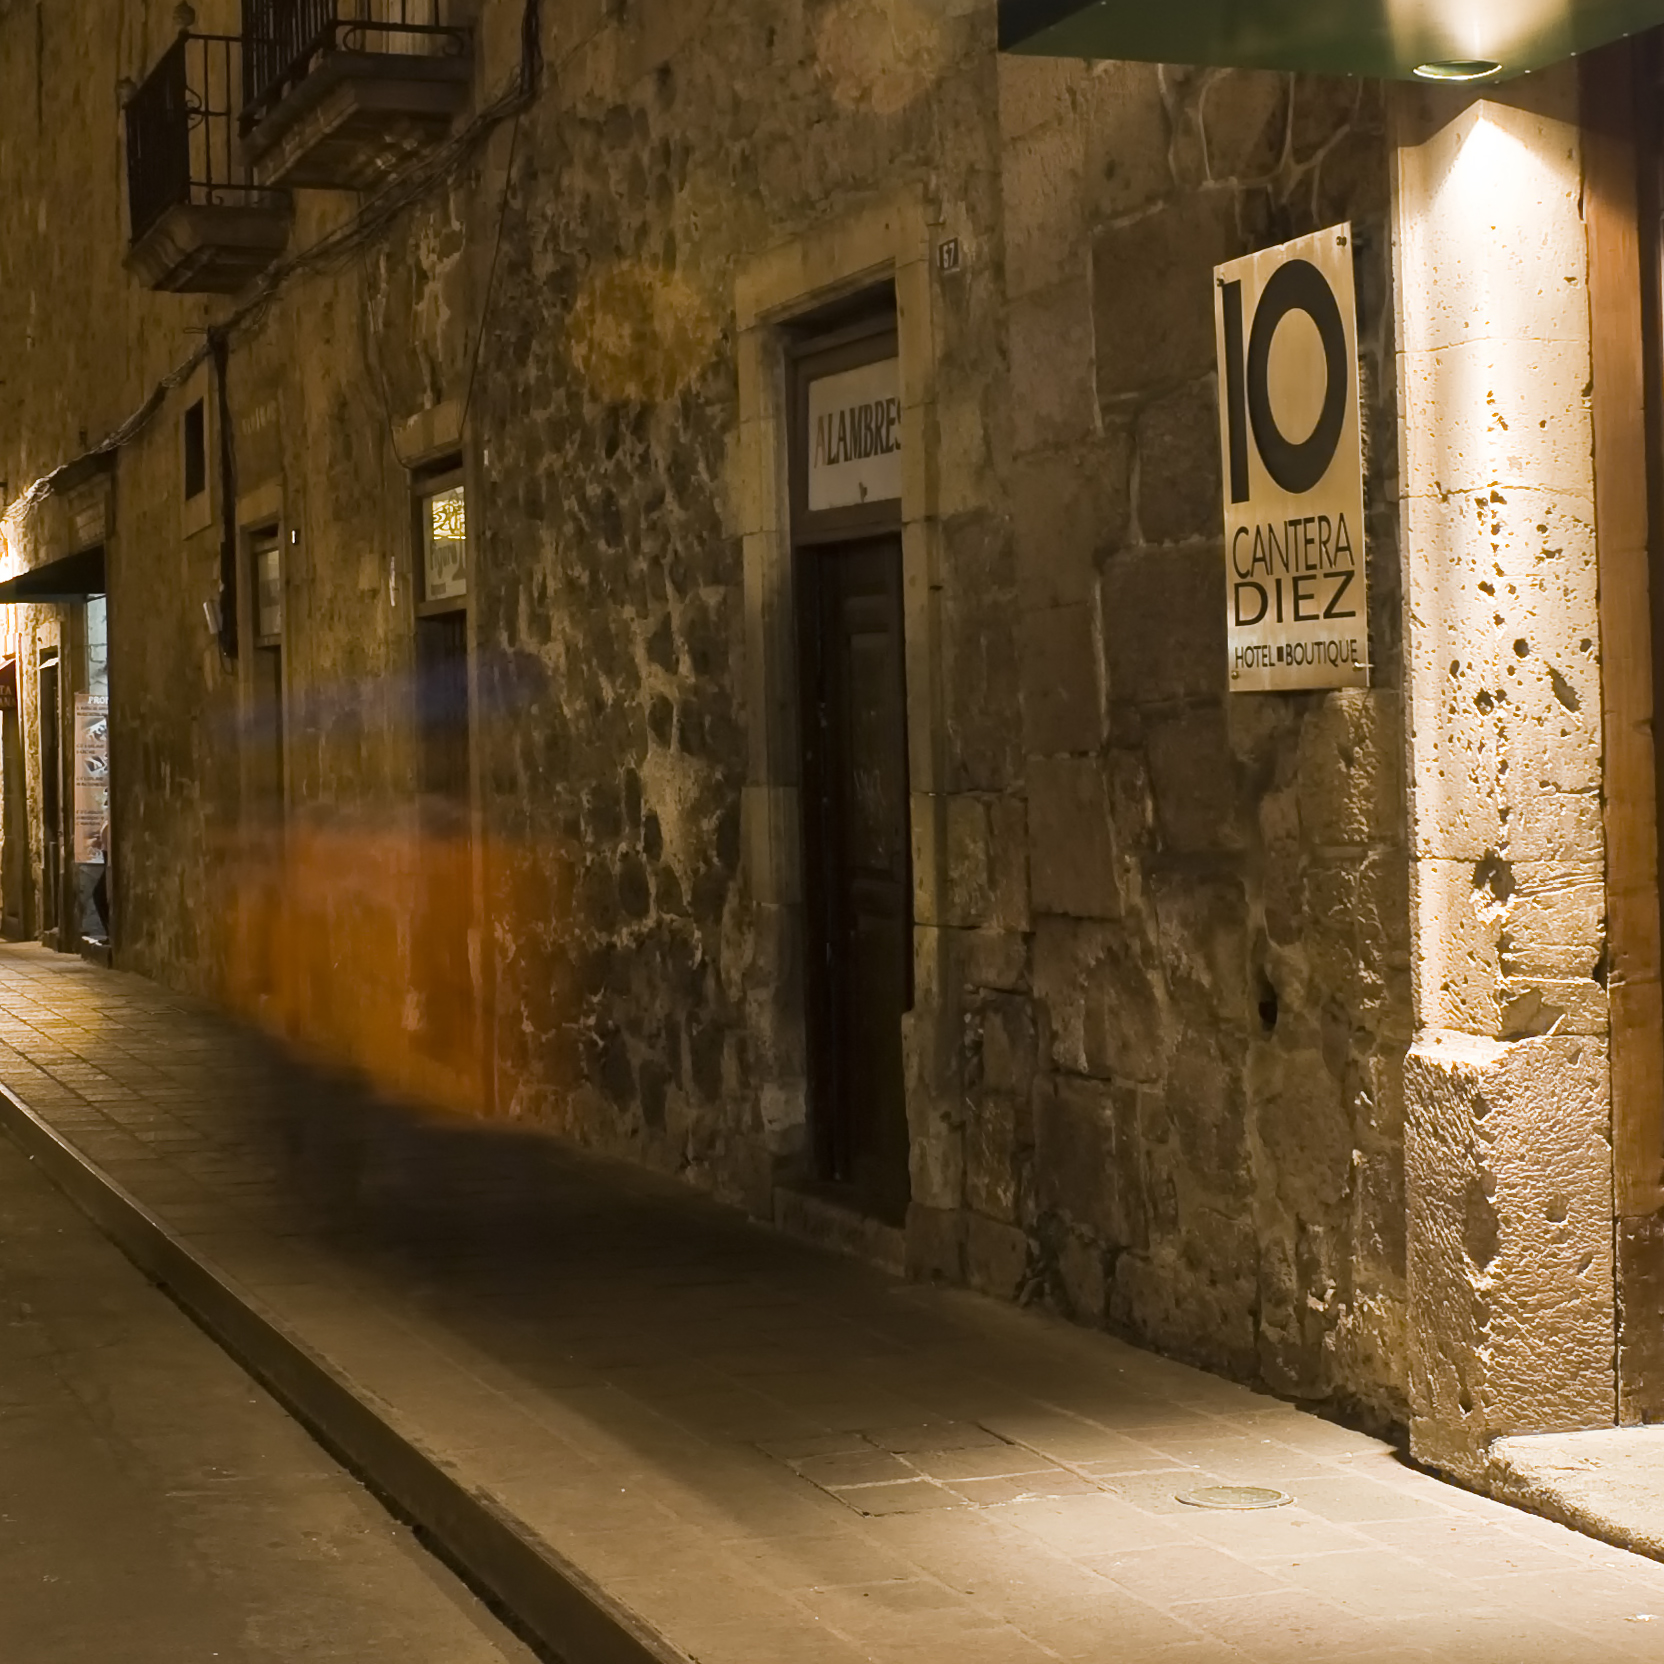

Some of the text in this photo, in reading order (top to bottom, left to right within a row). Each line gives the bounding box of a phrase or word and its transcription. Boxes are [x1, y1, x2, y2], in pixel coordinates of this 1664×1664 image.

[1232, 512, 1355, 579] CANTERA
[1233, 569, 1356, 627] DIEZ
[1234, 639, 1358, 669] HOTEL BOUTIQUE
